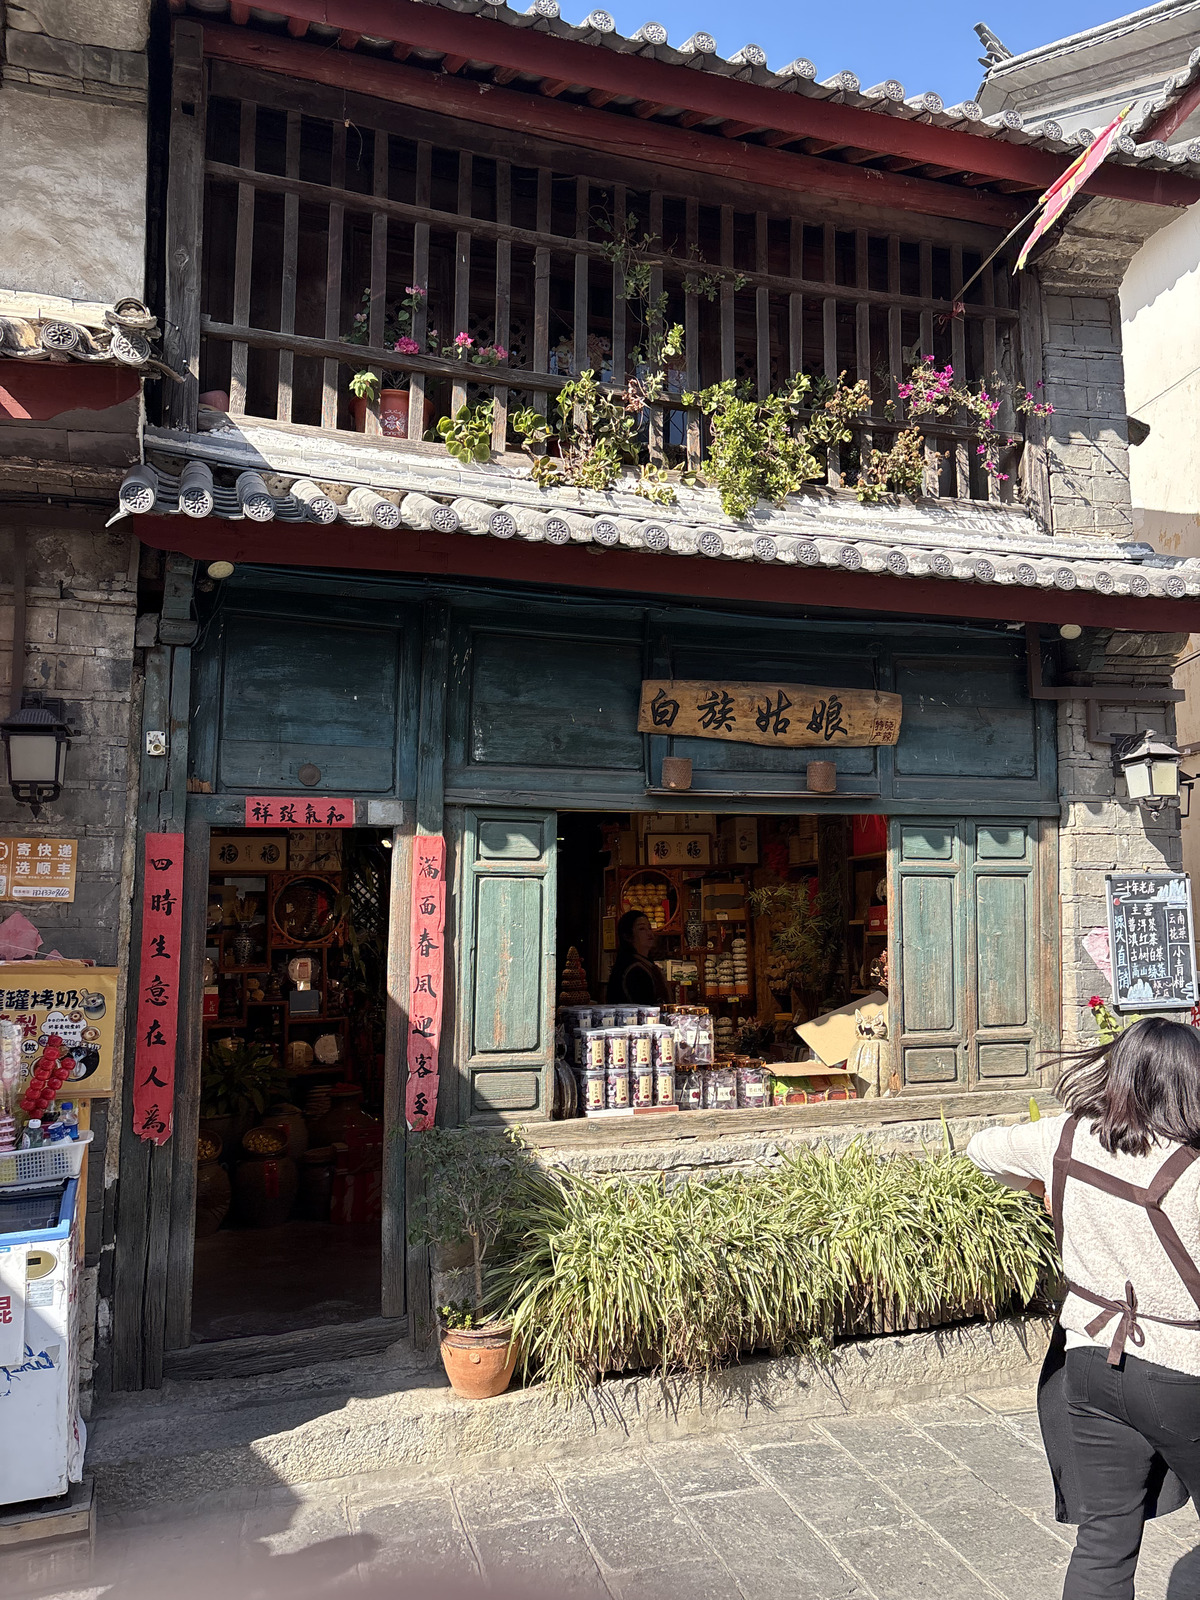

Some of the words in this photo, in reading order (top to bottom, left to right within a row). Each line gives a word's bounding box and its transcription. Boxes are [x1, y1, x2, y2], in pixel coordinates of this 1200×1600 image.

[651, 688, 848, 741] 白族姑娘
[17, 842, 72, 857] 寄快递
[15, 861, 71, 876] 选顺丰
[1115, 880, 1155, 895] 二十年老店
[1131, 903, 1154, 917] 主营
[1128, 932, 1158, 948] 滇红茶
[1114, 915, 1130, 990] 源头直销
[1130, 945, 1166, 963] 古树白茶
[1131, 962, 1167, 979] 高山绿茶
[1172, 945, 1186, 989] 小青柑
[412, 856, 440, 1116] 滿面春風迎客至
[0, 988, 79, 1011] 罐烤奶
[140, 857, 178, 1134] 四時生意在人為
